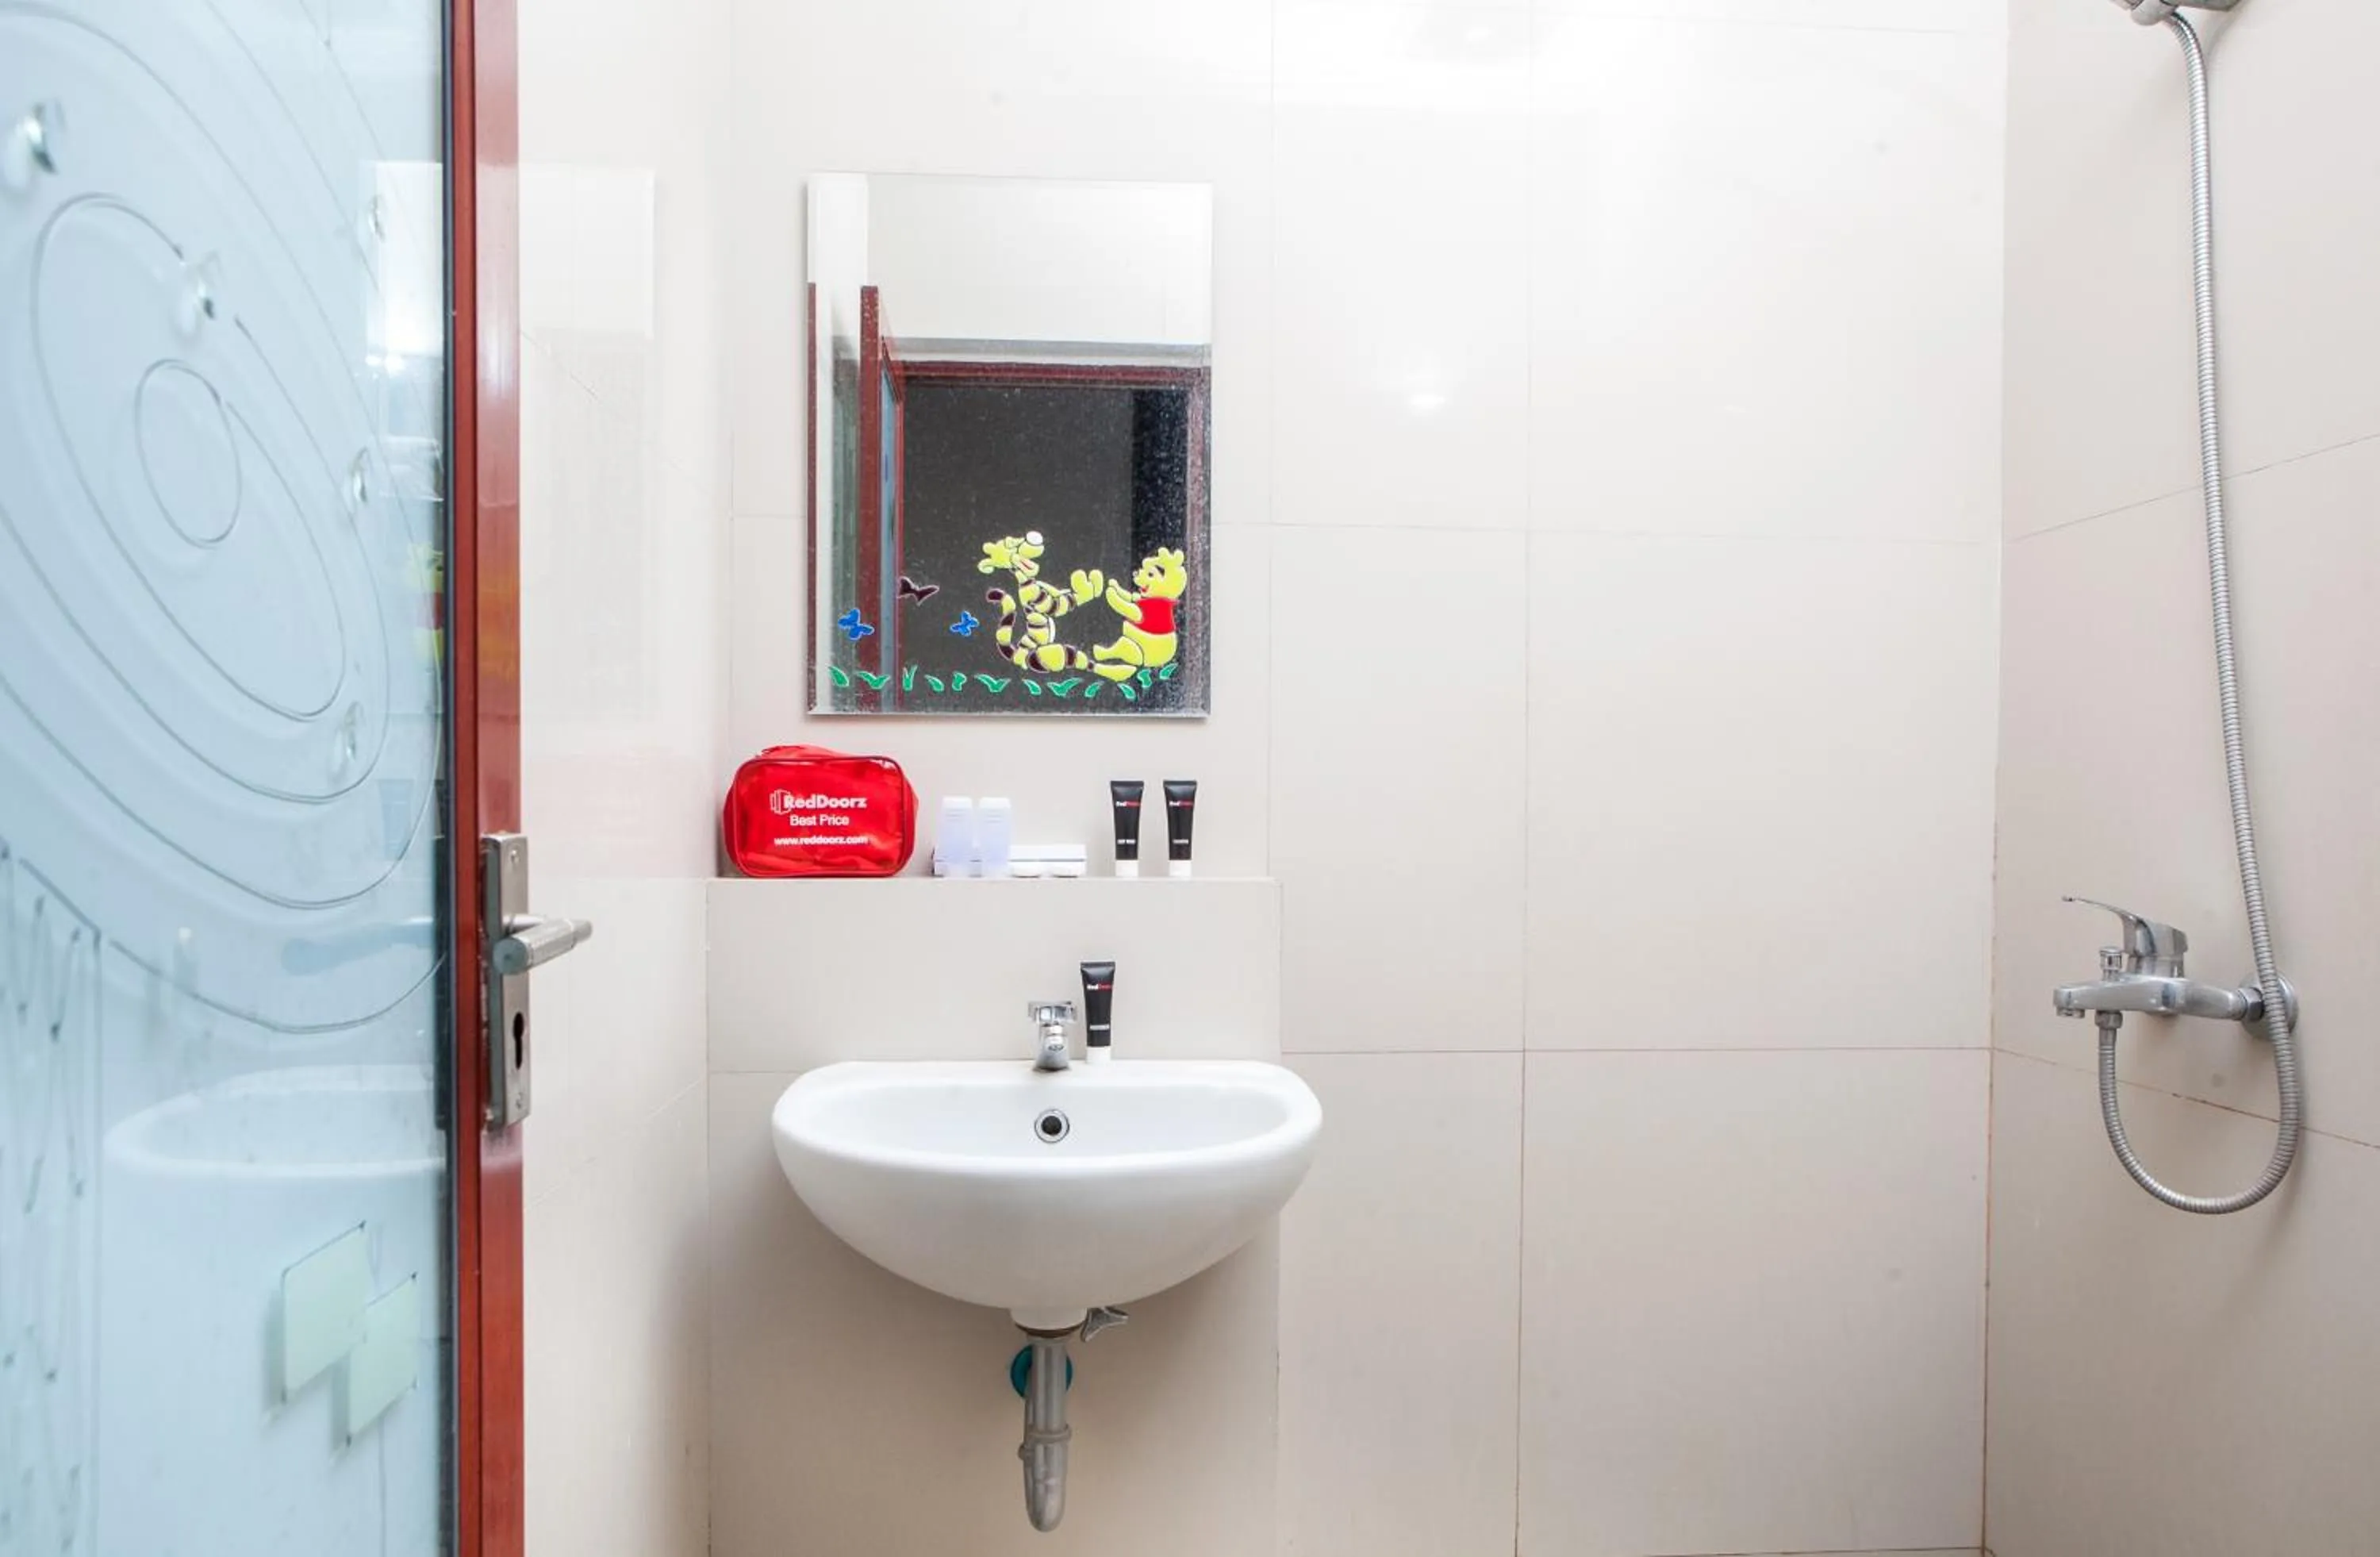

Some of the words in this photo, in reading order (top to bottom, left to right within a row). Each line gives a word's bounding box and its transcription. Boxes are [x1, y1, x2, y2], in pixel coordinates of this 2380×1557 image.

[783, 794, 868, 809] RedDoorz
[789, 814, 816, 826] Best
[820, 814, 850, 826] Price
